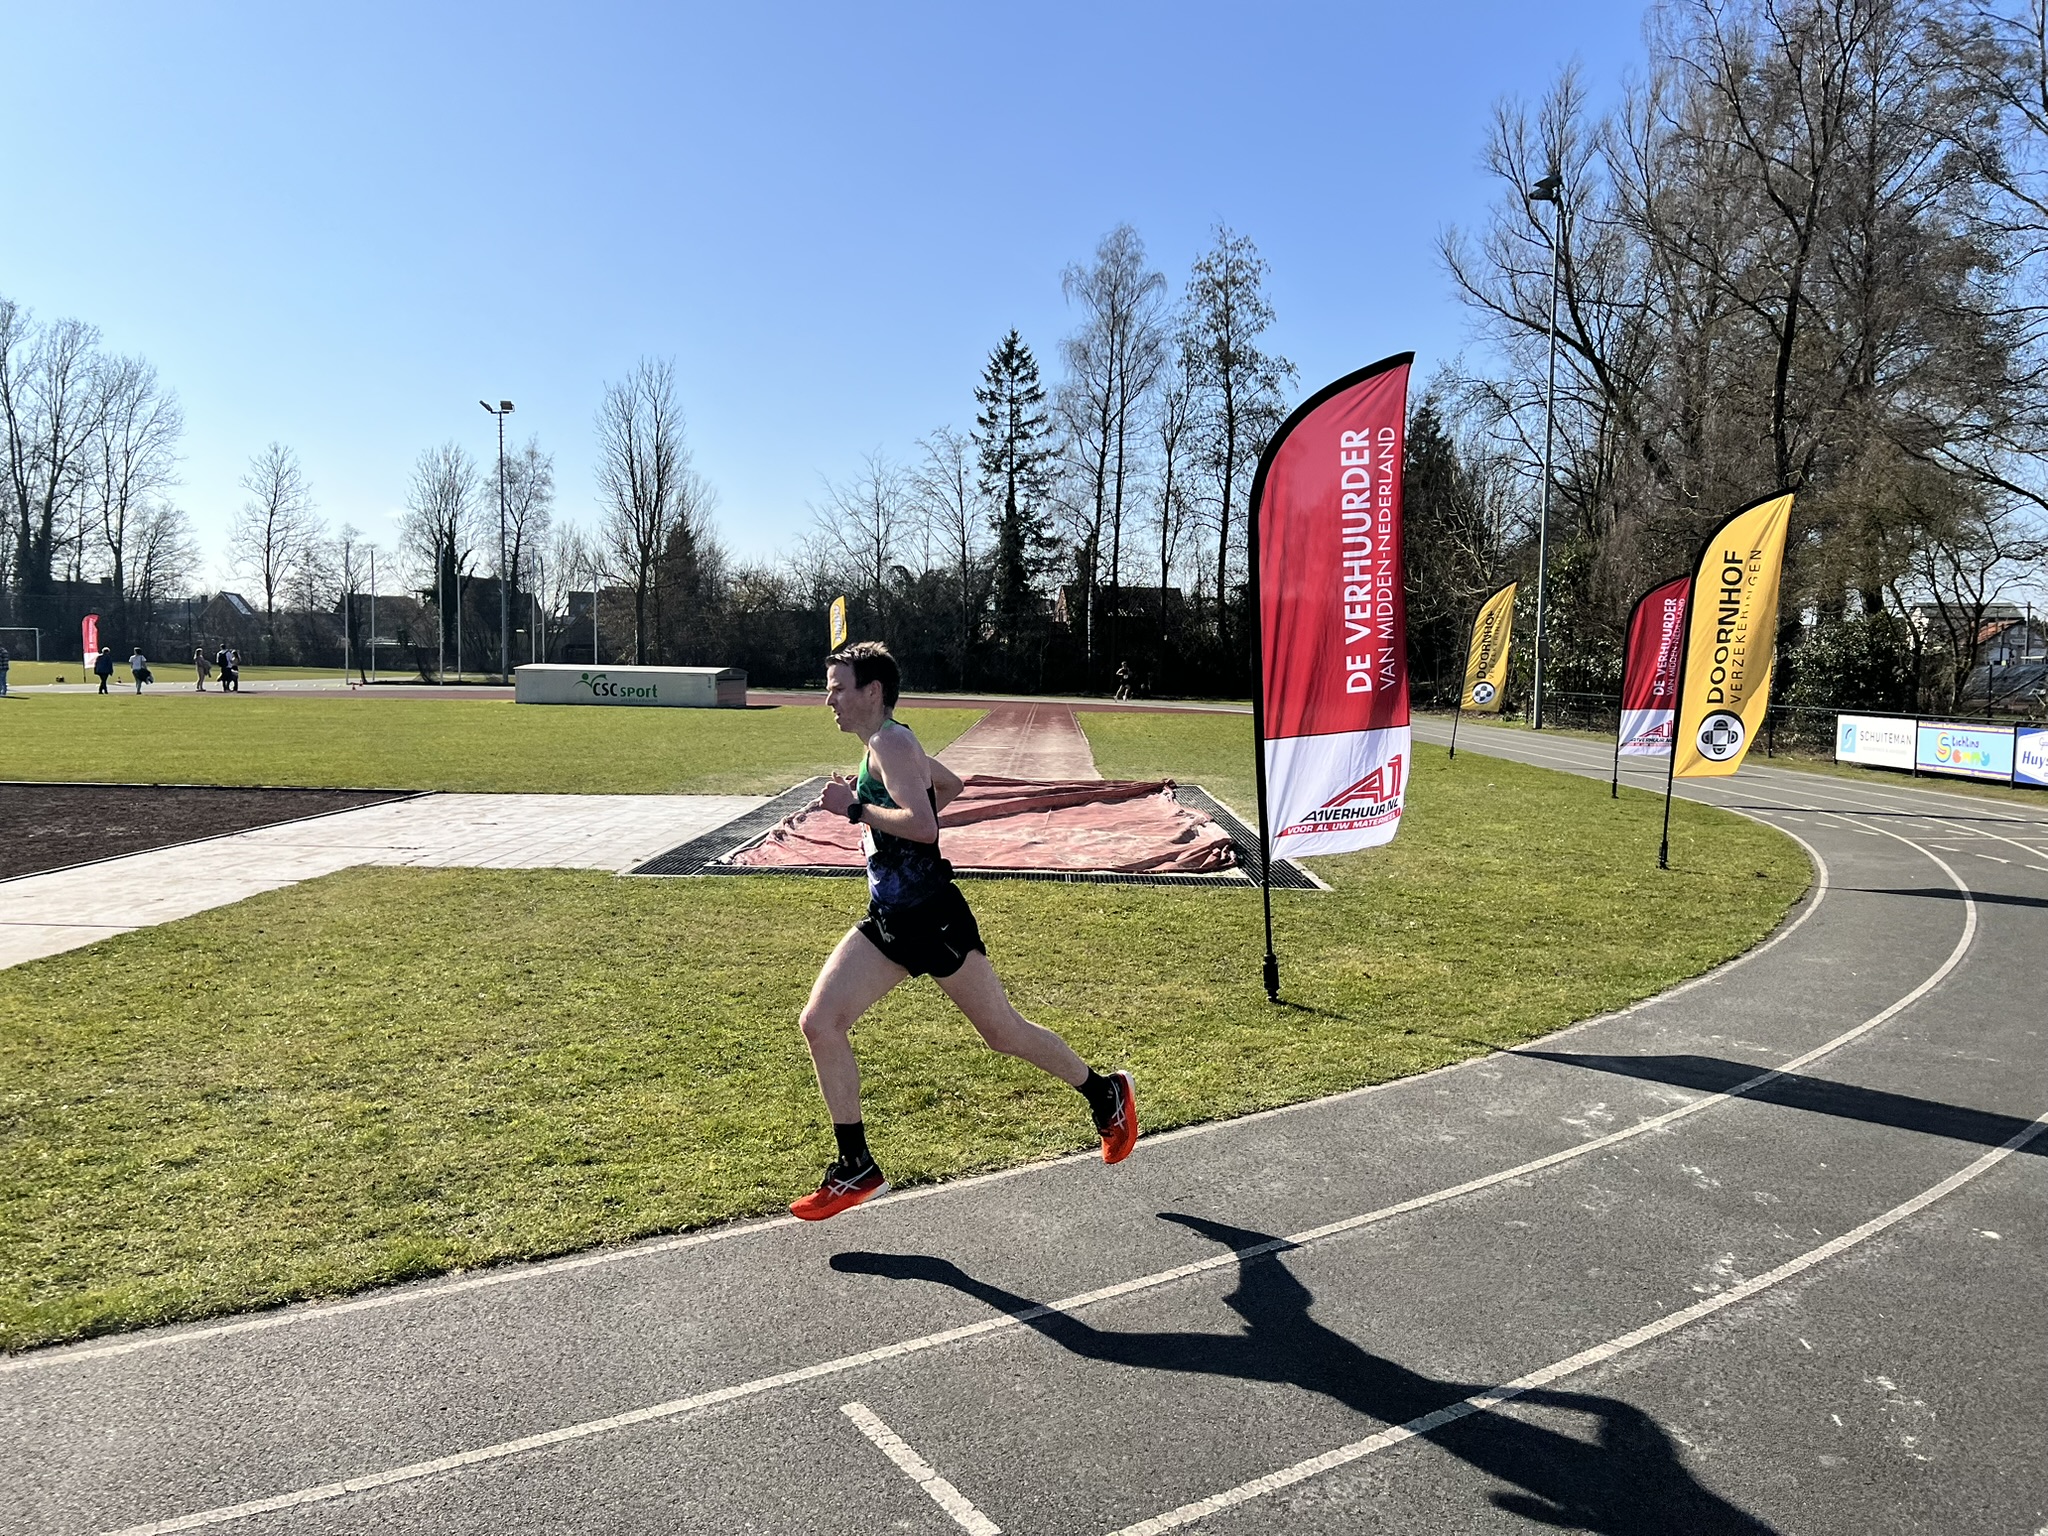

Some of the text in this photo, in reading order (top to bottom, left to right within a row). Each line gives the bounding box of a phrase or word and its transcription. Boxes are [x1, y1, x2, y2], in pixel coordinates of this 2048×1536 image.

[1341, 427, 1373, 694] DE VERHUURDER
[1376, 427, 1396, 691] VAN MIDDEN-NEDERLAND
[1653, 598, 1677, 695] DE VERHUURDER
[1706, 550, 1744, 704] DOORNHOF
[592, 682, 618, 697] CSC
[1667, 680, 1675, 695] VAN
[1860, 730, 1912, 745] SCHUITEMAN
[1320, 754, 1402, 808] A1
[1287, 825, 1314, 835] VOOR
[1316, 823, 1329, 832] AL
[1332, 821, 1350, 831] UW
[1299, 798, 1399, 824] A1VERHUUR.NL
